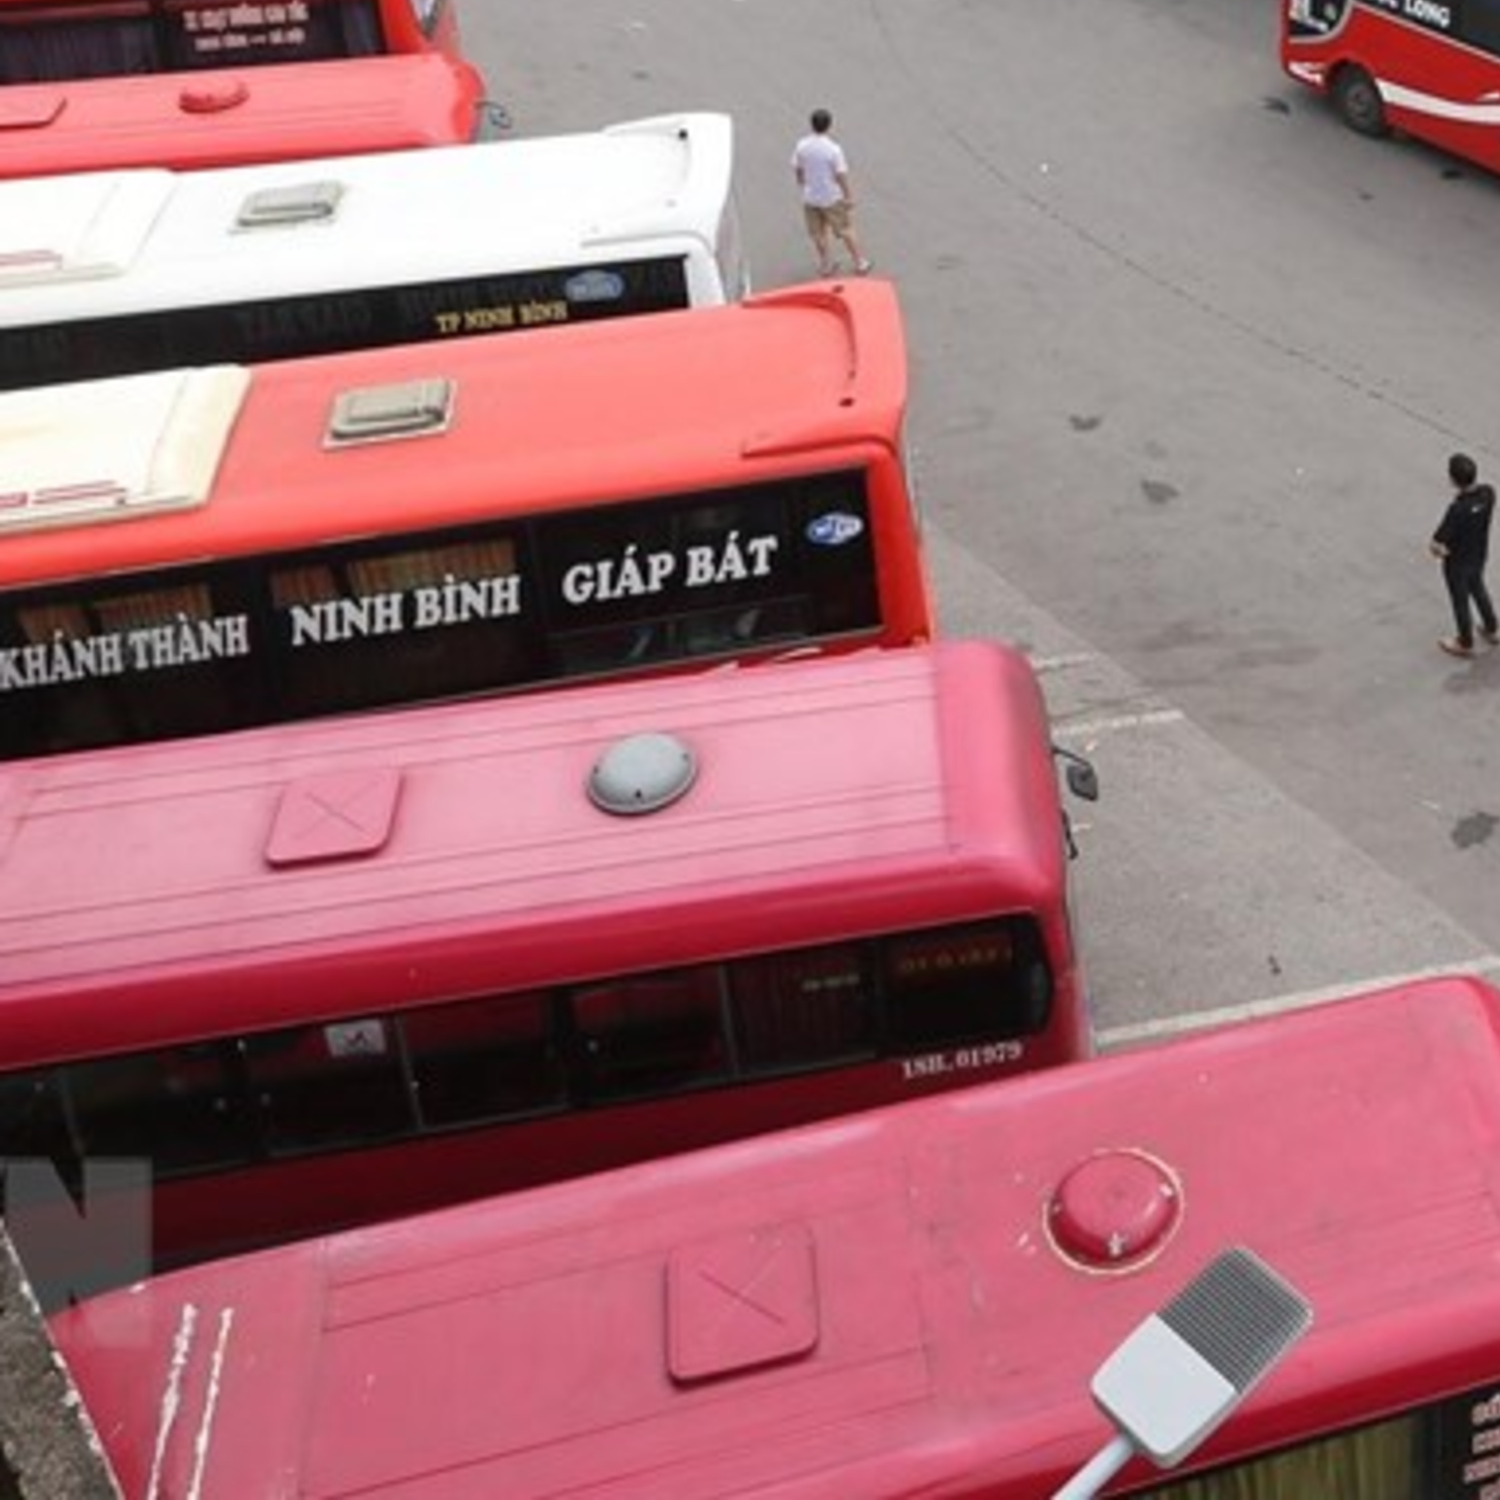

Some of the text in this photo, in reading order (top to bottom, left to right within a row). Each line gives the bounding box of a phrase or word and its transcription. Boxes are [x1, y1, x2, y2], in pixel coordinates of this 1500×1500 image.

[435, 298, 569, 333] TP NINH BÌNH
[0, 530, 778, 689] KHÁNH THÀNH NINH BÌNH GIÁP BÁT
